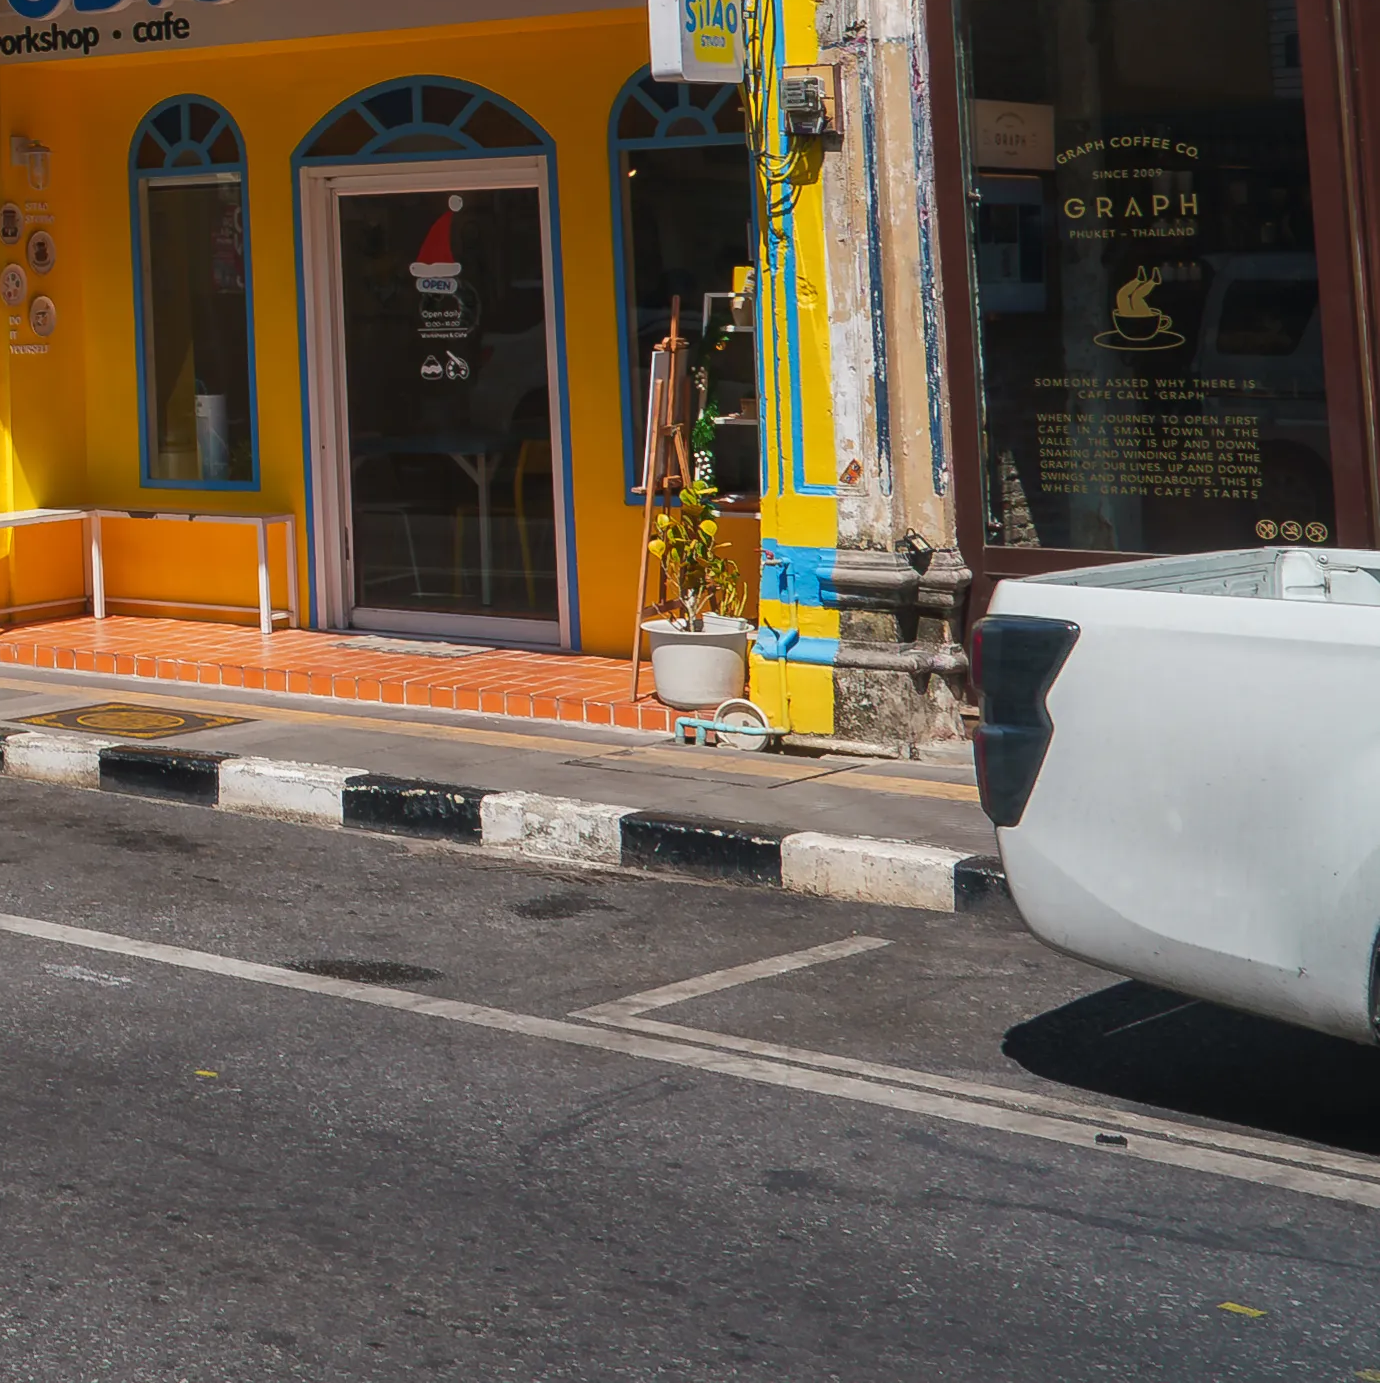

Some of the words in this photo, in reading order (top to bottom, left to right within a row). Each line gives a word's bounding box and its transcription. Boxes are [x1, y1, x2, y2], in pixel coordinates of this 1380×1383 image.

[132, 10, 190, 43] cafe
[700, 34, 726, 48] STUDIO
[1056, 139, 1105, 165] GRAPH
[1109, 136, 1170, 150] COFFEE
[1175, 142, 1200, 160] CO.
[1092, 169, 1129, 180] SINCE
[1133, 168, 1163, 179] 2009
[1063, 193, 1199, 219] GRAPH
[1069, 228, 1116, 240] PHUKET
[1130, 227, 1195, 239] THAILAND
[422, 279, 451, 291] OPEN
[421, 310, 443, 319] Open
[443, 309, 462, 319] daily
[9, 344, 51, 355] YOURSELF
[1034, 378, 1099, 388] SOMEONE
[1106, 378, 1149, 388] ASKED
[1155, 379, 1186, 388] WHY
[1193, 379, 1236, 389] THERE
[1243, 379, 1256, 389] IS
[1077, 390, 1112, 400] CAFE
[1116, 390, 1149, 400] CALL
[1036, 413, 1072, 423] WHEN
[1076, 414, 1096, 423] WE
[1101, 414, 1156, 424] JOURNEY
[1161, 415, 1179, 425] TO
[1184, 415, 1219, 425] OPEN
[1224, 415, 1259, 426] FIRST
[1037, 425, 1070, 435] CAFE
[1076, 426, 1091, 435] IN
[1097, 426, 1107, 435] A
[1112, 426, 1156, 436] SMALL
[1161, 427, 1204, 437] TOWN
[1211, 428, 1226, 437] IN
[1233, 428, 1260, 438] THE
[1088, 437, 1110, 447] THE
[1113, 438, 1142, 447] WAY
[1145, 438, 1158, 448] IS
[1162, 439, 1179, 449] UP
[1183, 440, 1210, 449] AND
[1039, 448, 1090, 459] SNAKING
[1093, 449, 1120, 459] AND
[1122, 450, 1177, 461] WINDING
[1180, 451, 1215, 462] SAME
[1217, 452, 1234, 462] AS
[1236, 452, 1262, 463] THE
[1039, 460, 1078, 470] GRAPH
[1081, 461, 1098, 470] OF
[1101, 461, 1126, 471] OUR
[1167, 462, 1184, 473] UP
[1187, 463, 1214, 474] AND
[1040, 471, 1086, 482] SWINGS
[1089, 472, 1116, 482] AND
[1220, 476, 1247, 487] THIS
[1251, 477, 1263, 488] IS
[1040, 483, 1089, 494] WHERE
[1203, 488, 1259, 499] STARTS
